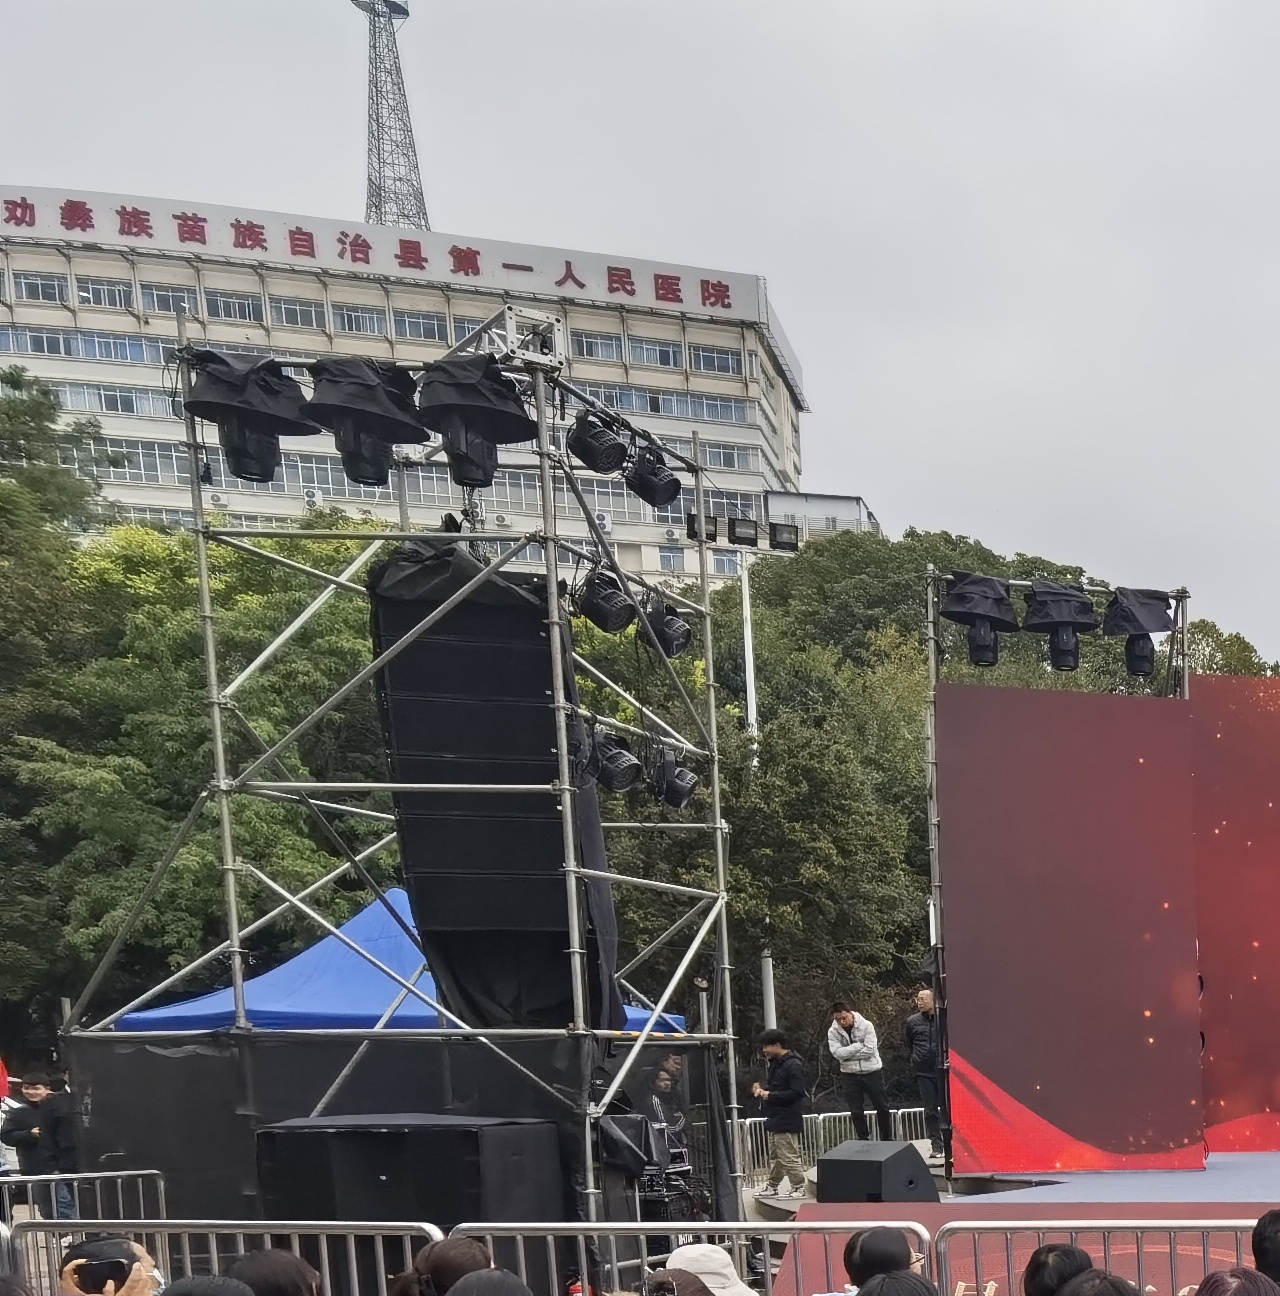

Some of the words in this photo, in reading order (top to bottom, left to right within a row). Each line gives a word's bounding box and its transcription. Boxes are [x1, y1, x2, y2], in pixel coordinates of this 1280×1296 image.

[3, 196, 732, 309] 劝彝族苗族自治县第一人民医院
